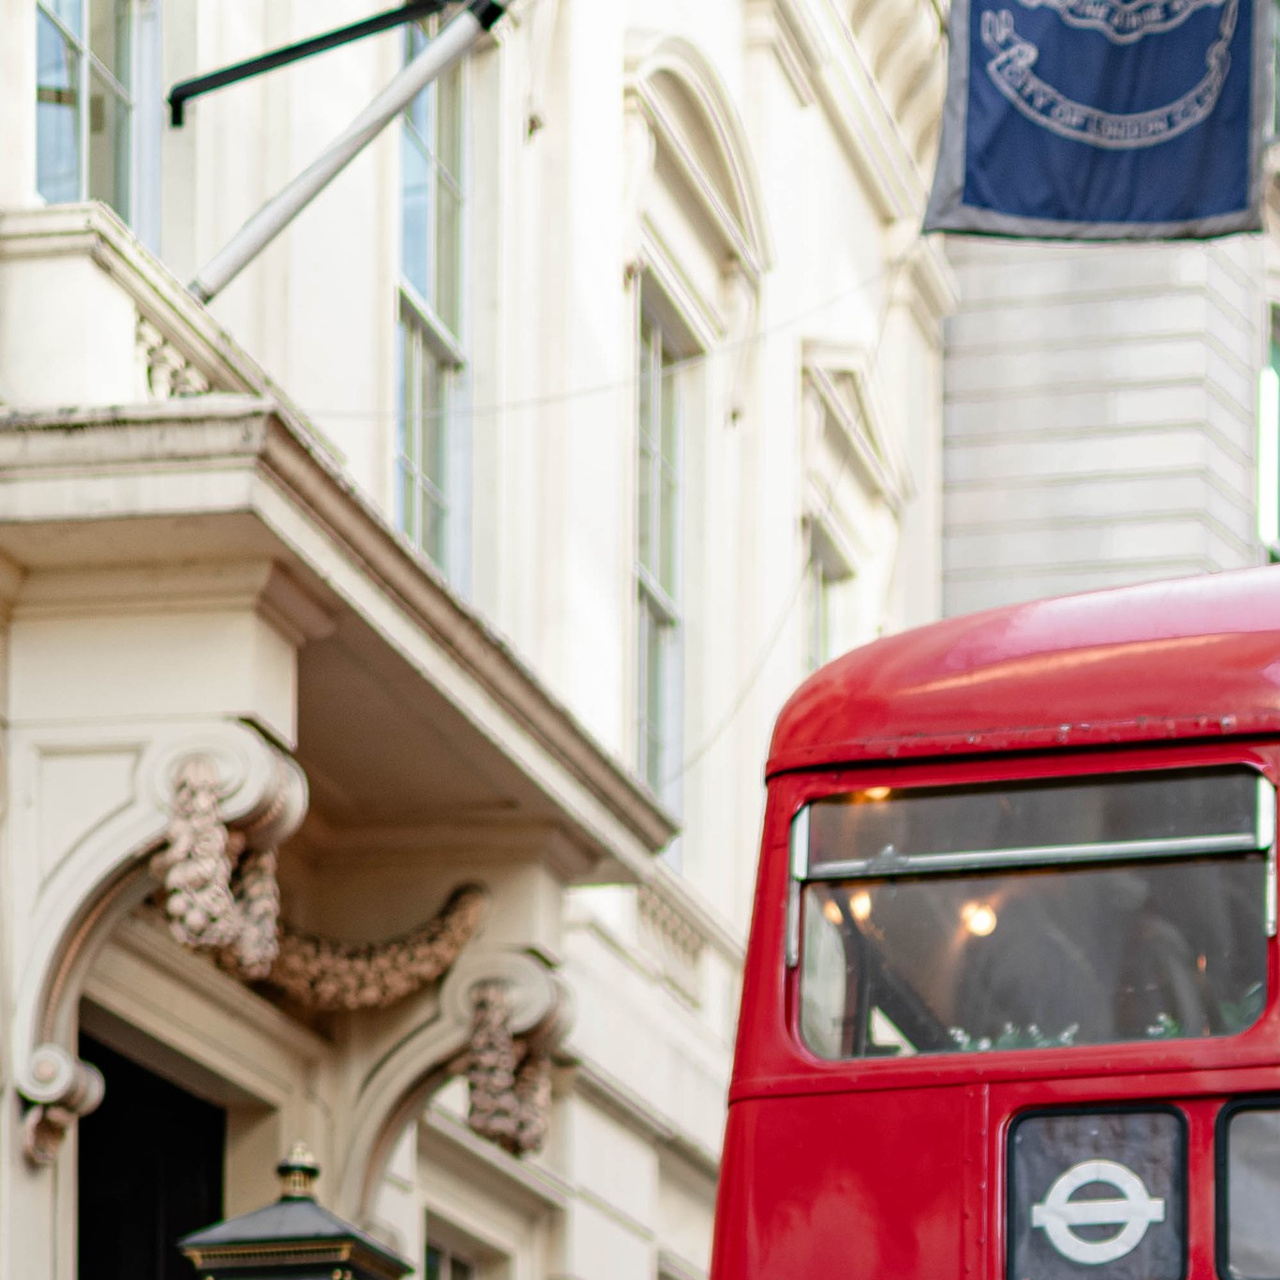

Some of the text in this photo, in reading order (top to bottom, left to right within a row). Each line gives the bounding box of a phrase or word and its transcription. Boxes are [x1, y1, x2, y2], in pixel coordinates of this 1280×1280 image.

[1001, 64, 1050, 109] CITY
[1051, 103, 1085, 130] OF
[1091, 114, 1168, 140] LONDON
